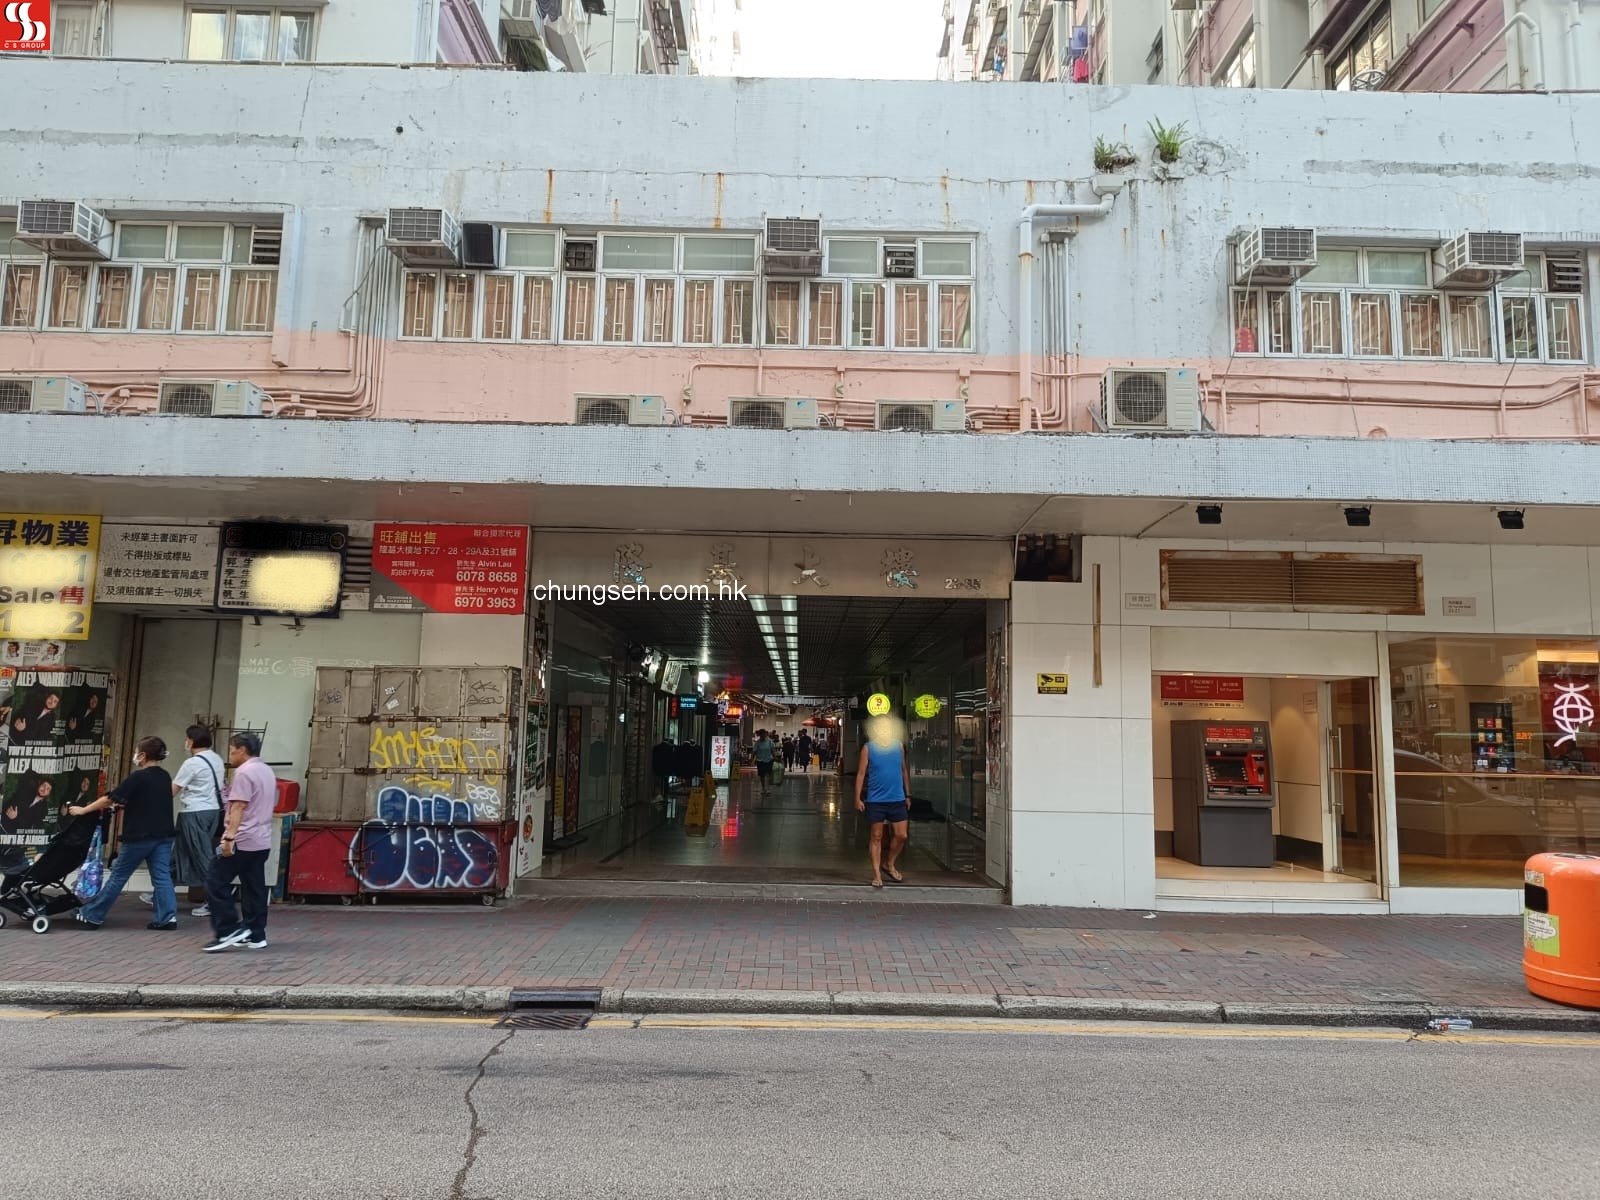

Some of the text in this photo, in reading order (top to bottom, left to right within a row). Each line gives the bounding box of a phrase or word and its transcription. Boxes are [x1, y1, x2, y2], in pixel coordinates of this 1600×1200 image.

[498, 560, 512, 568] Lau
[456, 571, 517, 582] 6078 8658
[0, 586, 84, 606] Sale 售
[477, 586, 497, 595] Henry
[499, 586, 519, 595] Yung
[455, 597, 516, 609] 6970 3963
[16, 671, 37, 686] ALEX
[7, 758, 31, 774] ALEX
